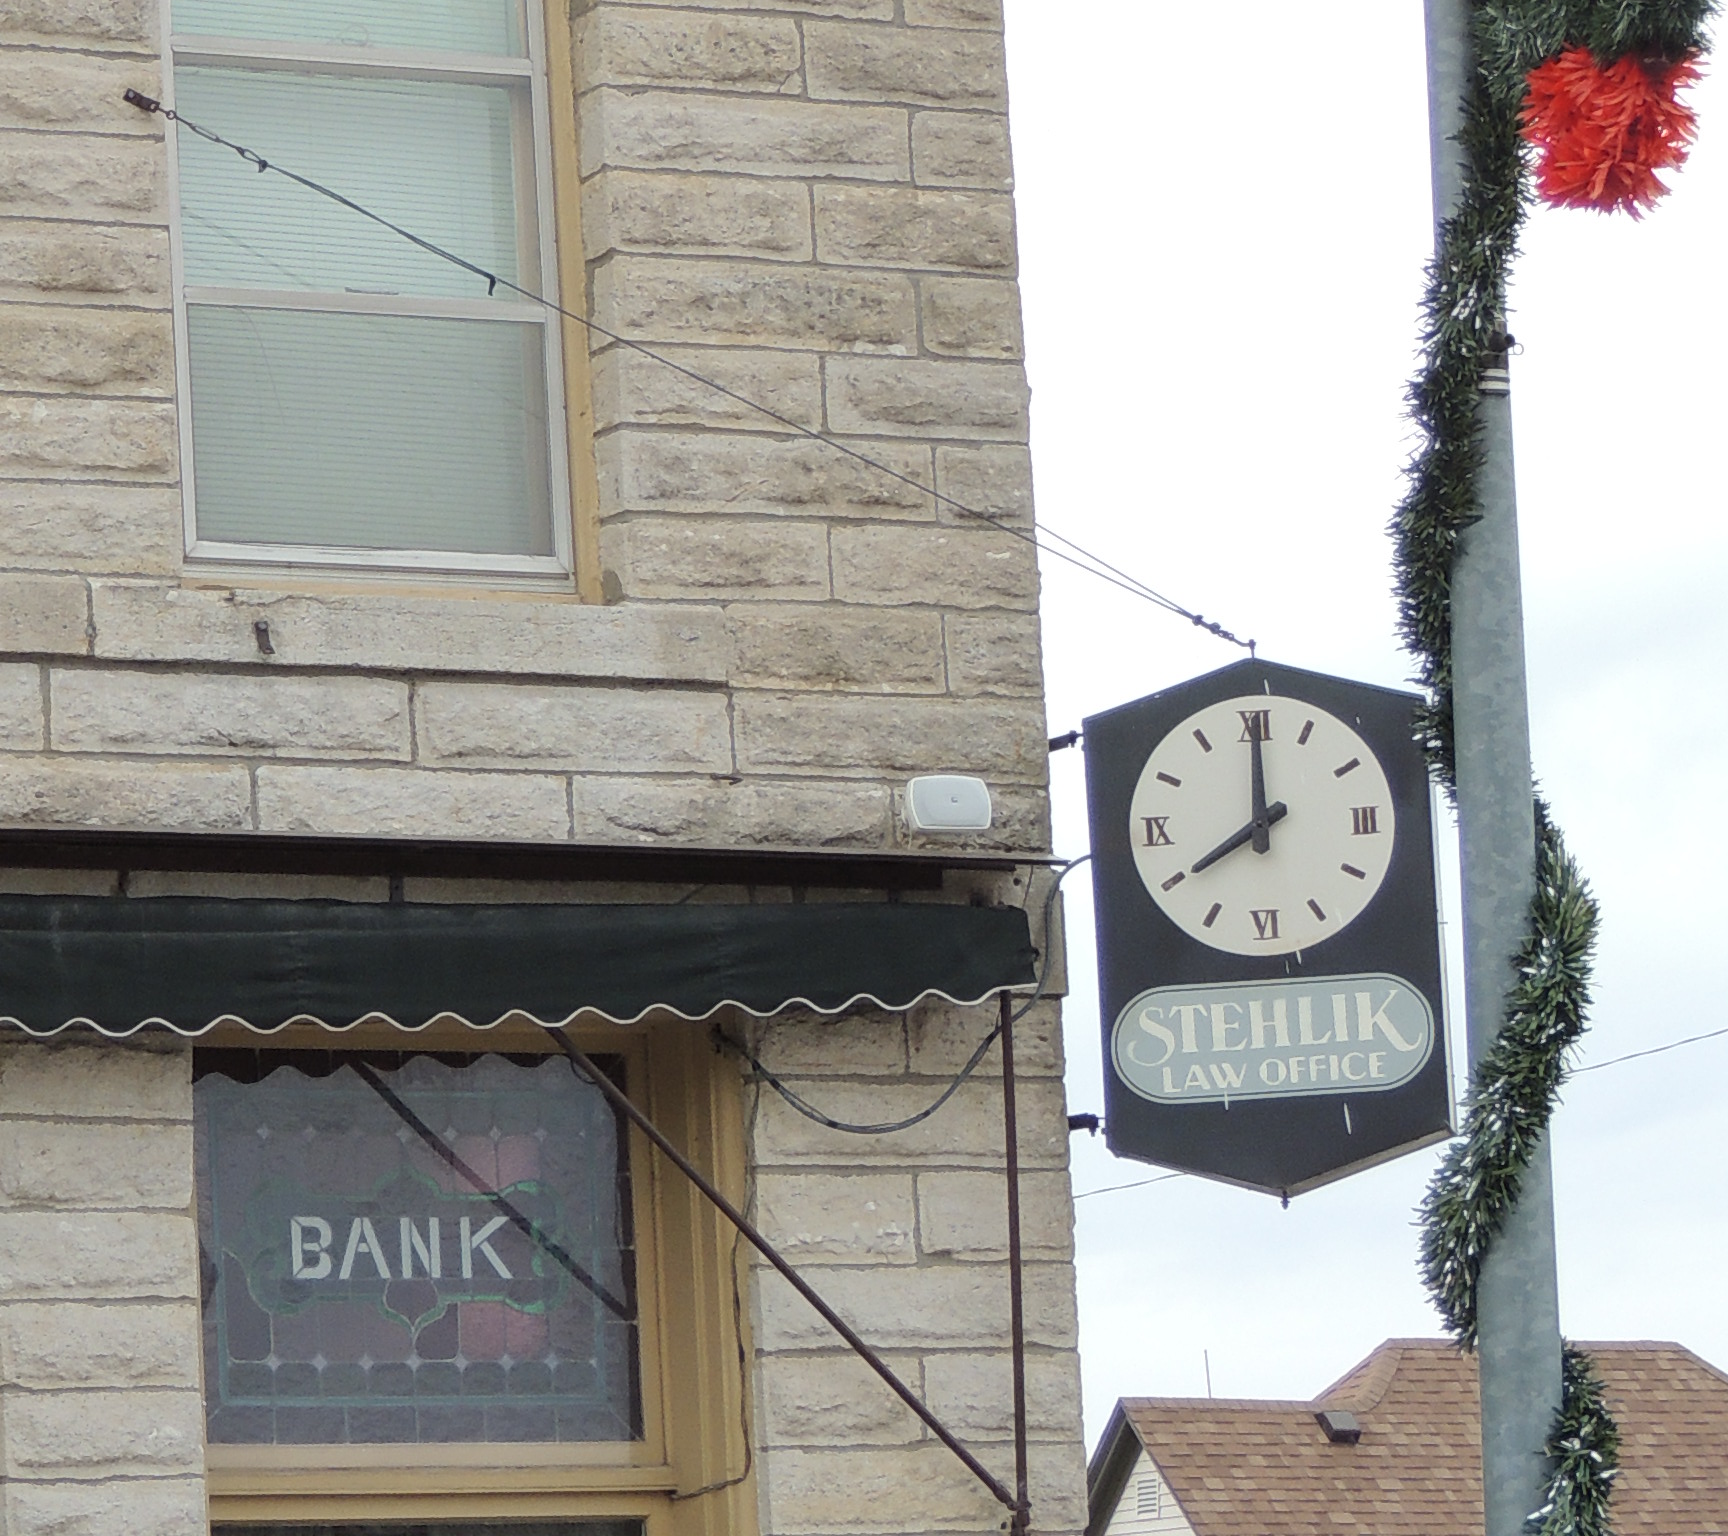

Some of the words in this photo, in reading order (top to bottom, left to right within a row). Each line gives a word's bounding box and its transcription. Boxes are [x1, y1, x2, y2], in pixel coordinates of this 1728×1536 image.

[1140, 816, 1174, 846] IX
[1350, 806, 1380, 835] III
[1249, 909, 1281, 940] VI
[1125, 989, 1422, 1067] STEHLIK
[1162, 1062, 1246, 1094] LAW
[1258, 1051, 1387, 1085] OFFICE
[290, 1216, 513, 1280] BANK
